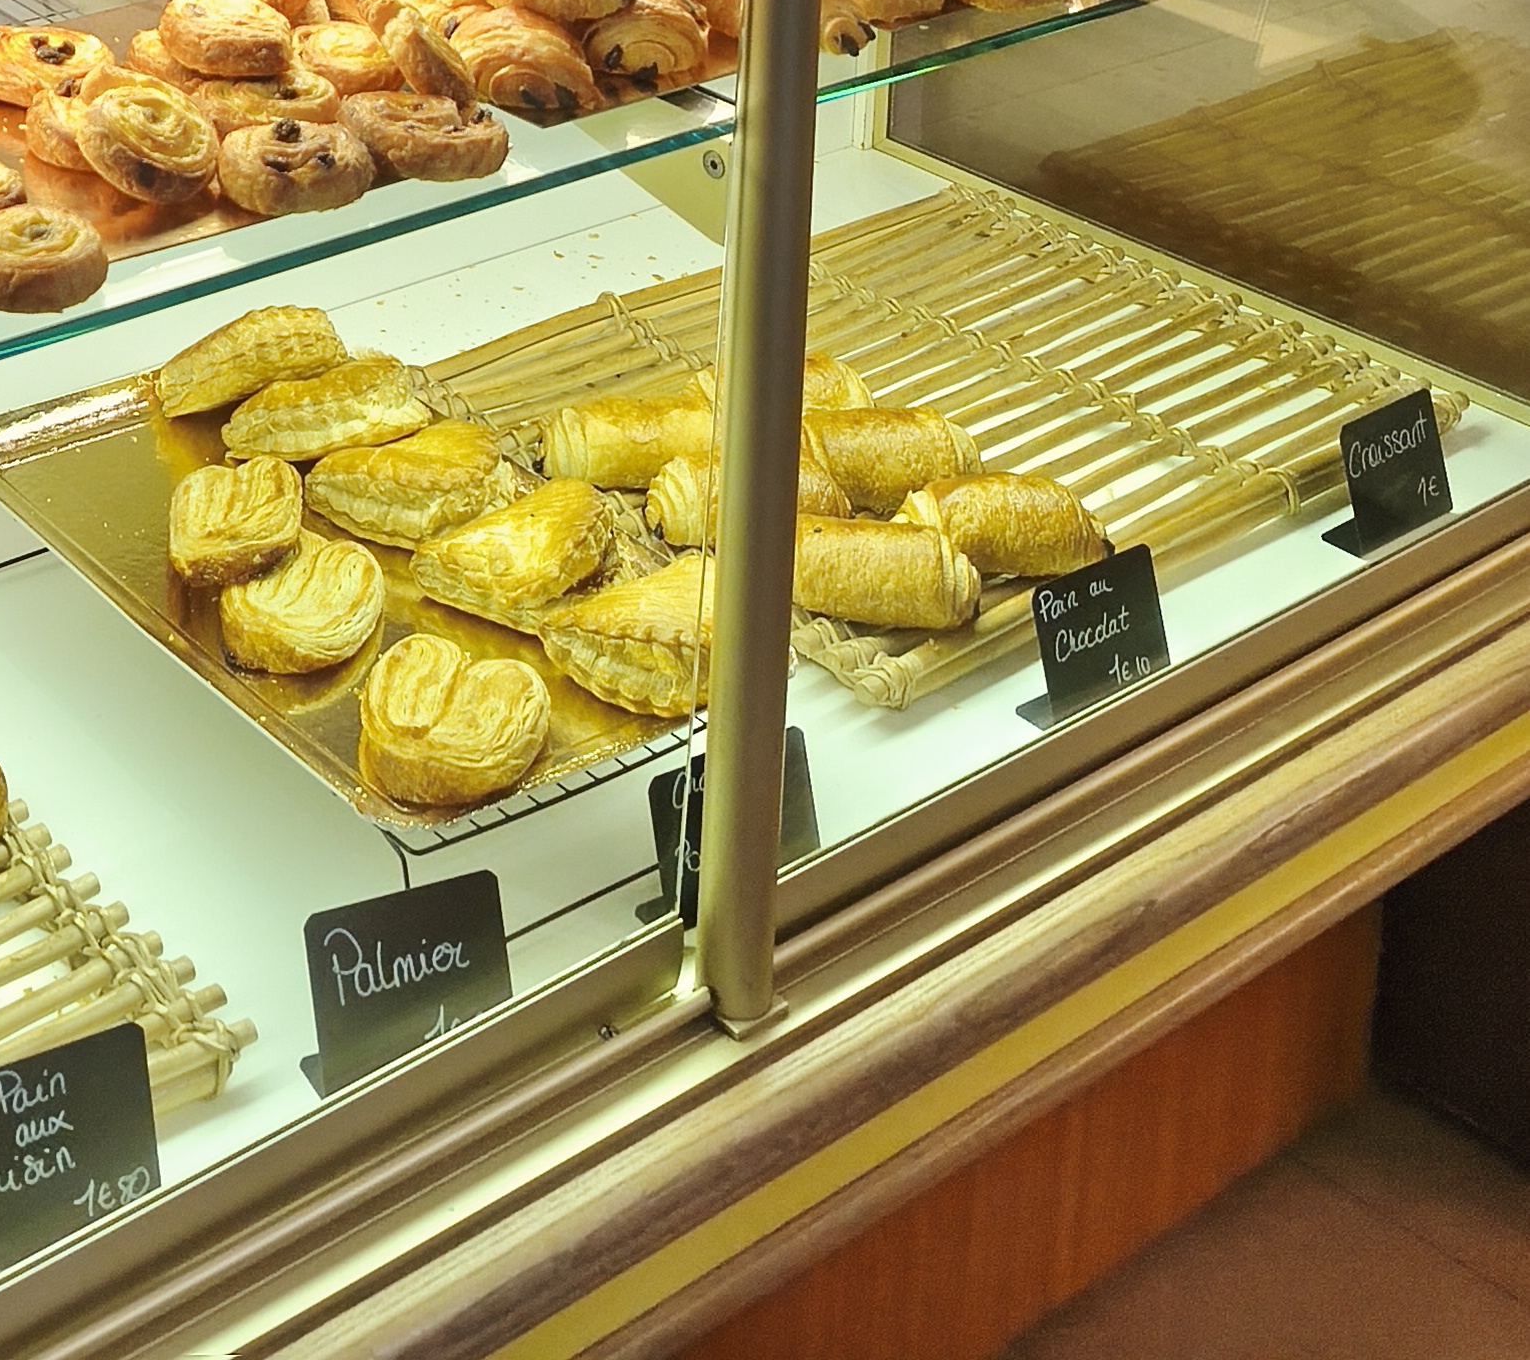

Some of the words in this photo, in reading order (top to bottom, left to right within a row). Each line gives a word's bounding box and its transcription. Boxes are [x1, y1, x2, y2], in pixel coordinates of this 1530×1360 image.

[1349, 409, 1428, 478] Croissant
[1417, 476, 1440, 506] 1€
[1039, 590, 1078, 623] Pain
[1089, 579, 1113, 597] au
[1055, 605, 1130, 662] Chocolat
[324, 928, 470, 1006] Palmier
[15, 1110, 74, 1147] aux
[73, 1166, 150, 1217] 1€80
